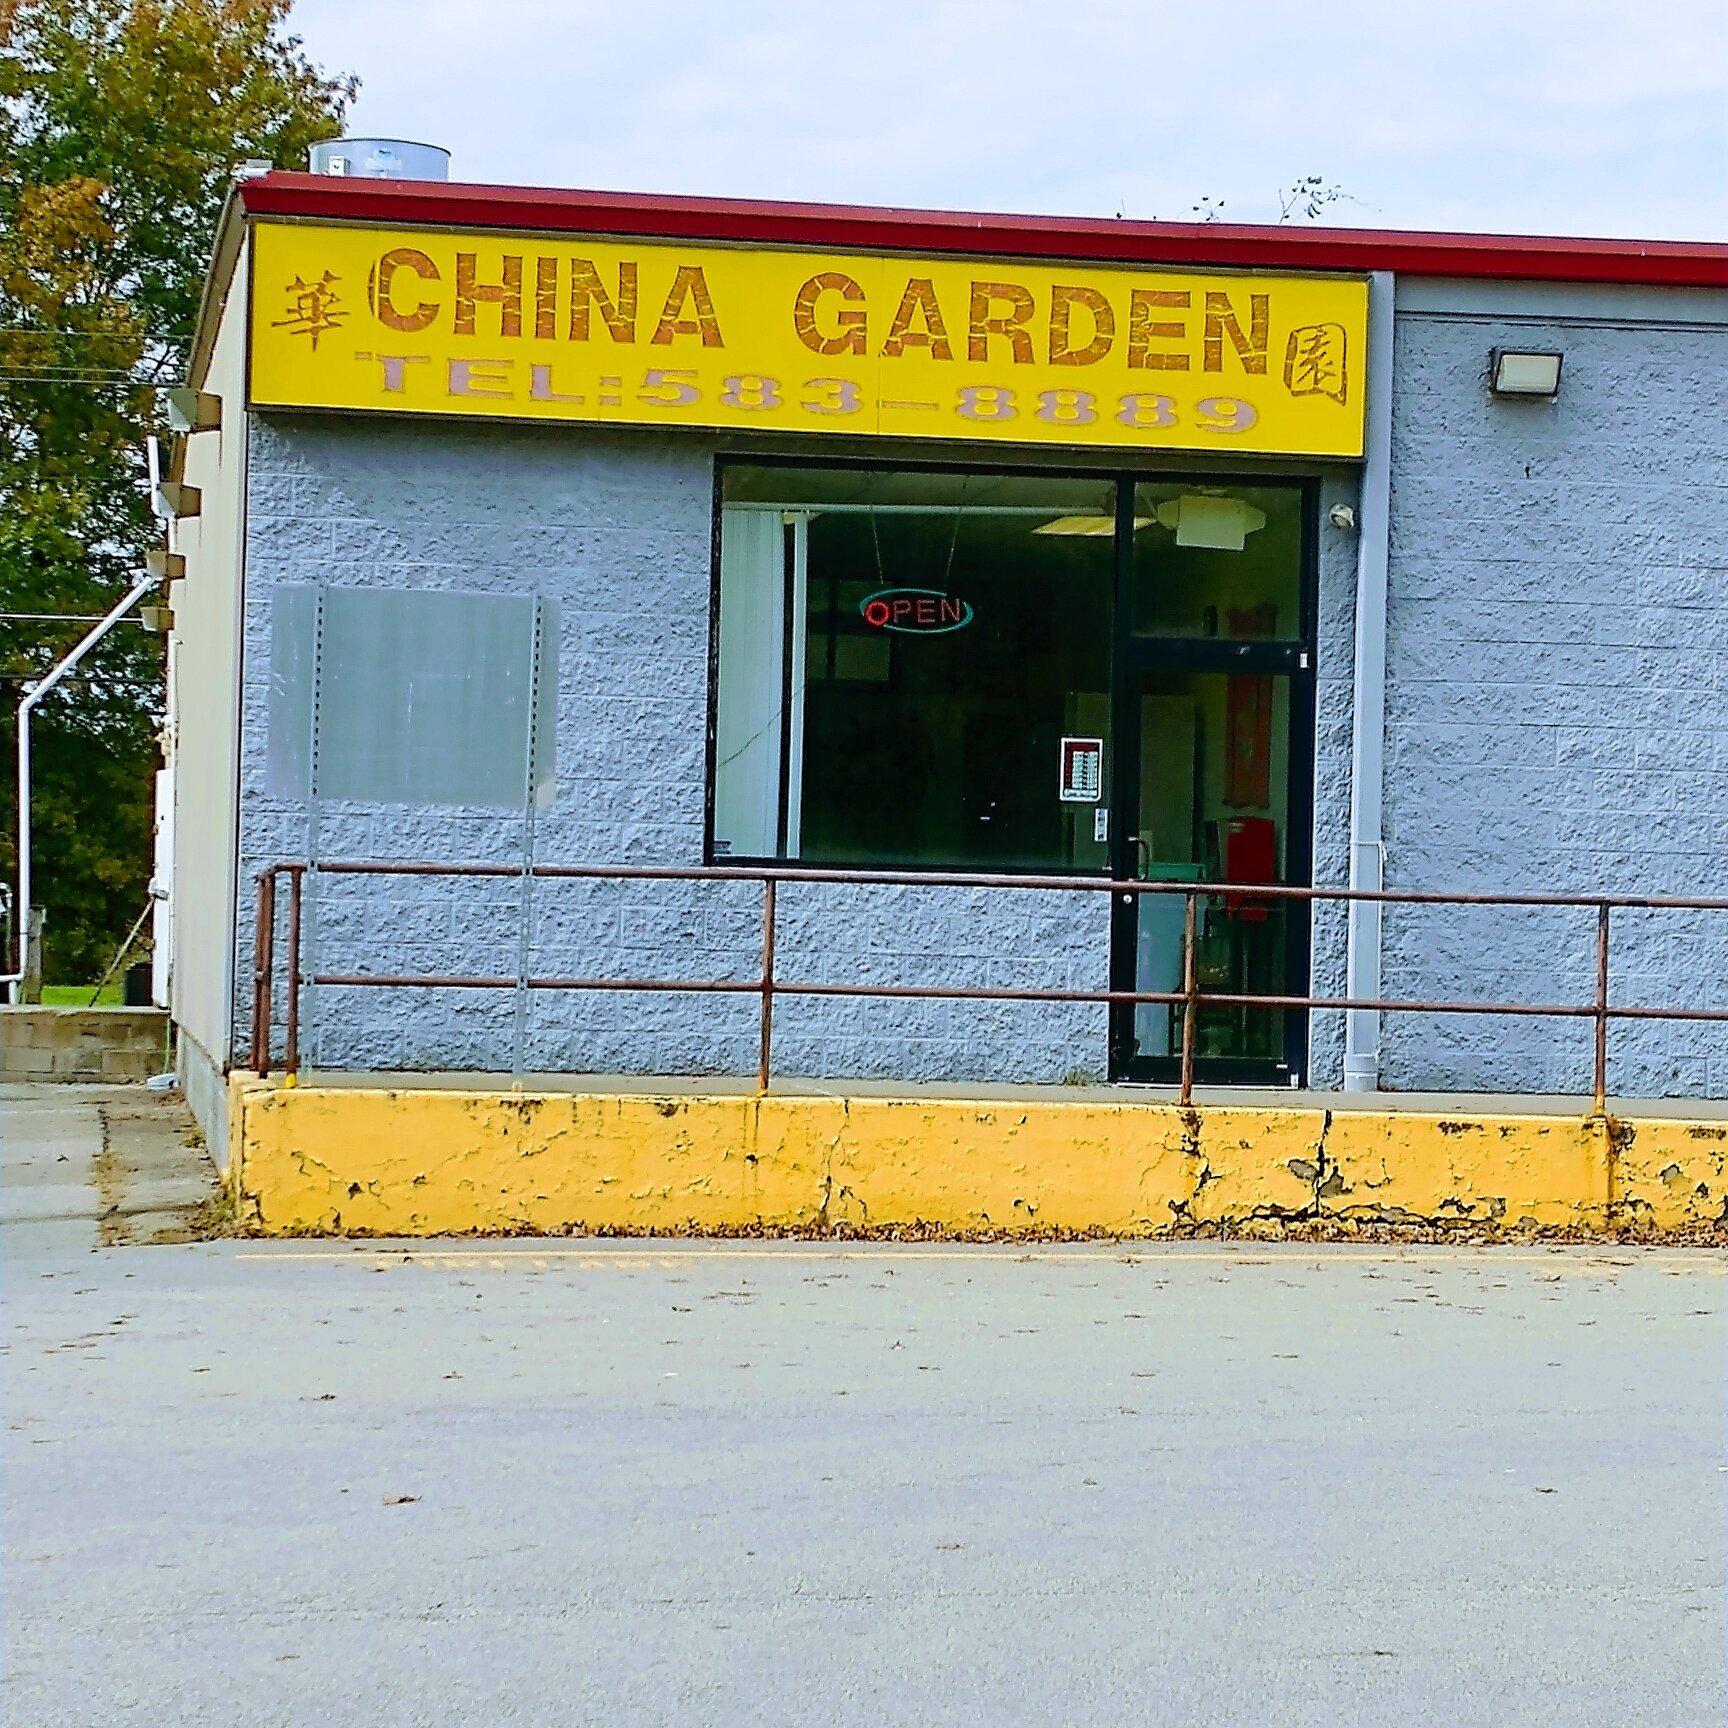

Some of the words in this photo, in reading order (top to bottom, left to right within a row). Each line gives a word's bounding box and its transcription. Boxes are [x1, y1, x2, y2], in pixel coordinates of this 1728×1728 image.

[367, 247, 726, 349] CHINA
[793, 271, 1270, 376] GARDEN
[864, 598, 960, 626] OPEN
